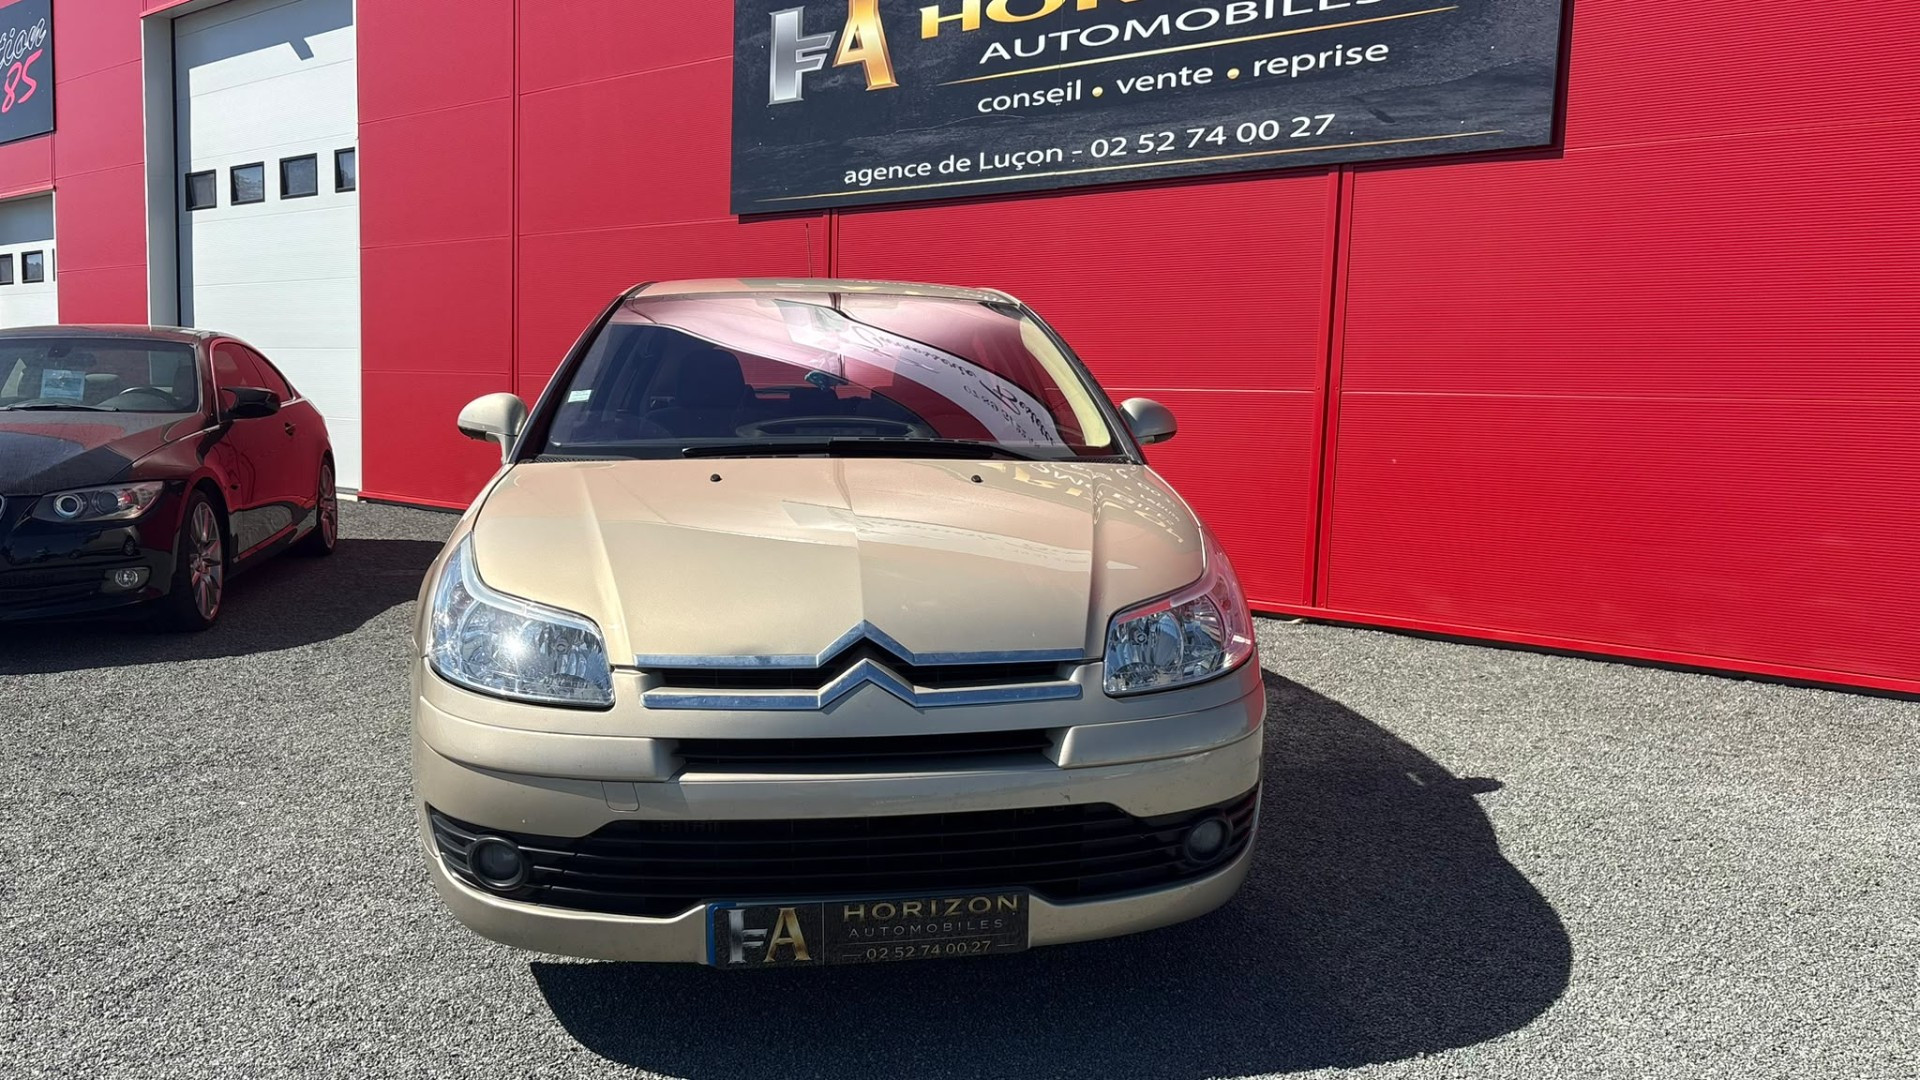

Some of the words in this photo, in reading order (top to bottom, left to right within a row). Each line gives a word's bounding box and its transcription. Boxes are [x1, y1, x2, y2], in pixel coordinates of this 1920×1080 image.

[1, 48, 43, 113] 85
[977, 79, 1082, 113] conseil
[1116, 66, 1214, 95] vente
[1253, 43, 1389, 78] reprise
[844, 164, 932, 186] agence
[938, 154, 971, 175] de
[979, 147, 1063, 172] Luçon
[1090, 136, 1128, 159] 02
[1137, 131, 1176, 154] 52
[1186, 125, 1227, 149] 74
[1236, 119, 1280, 143] 00
[1290, 113, 1336, 138] 27
[843, 894, 1018, 922] HORIZON
[849, 918, 1003, 938] AUTOMOBILES
[866, 947, 888, 960] 02
[894, 945, 915, 958] 52
[921, 943, 940, 957] 74
[946, 942, 967, 954] 00
[971, 940, 991, 953] 27
